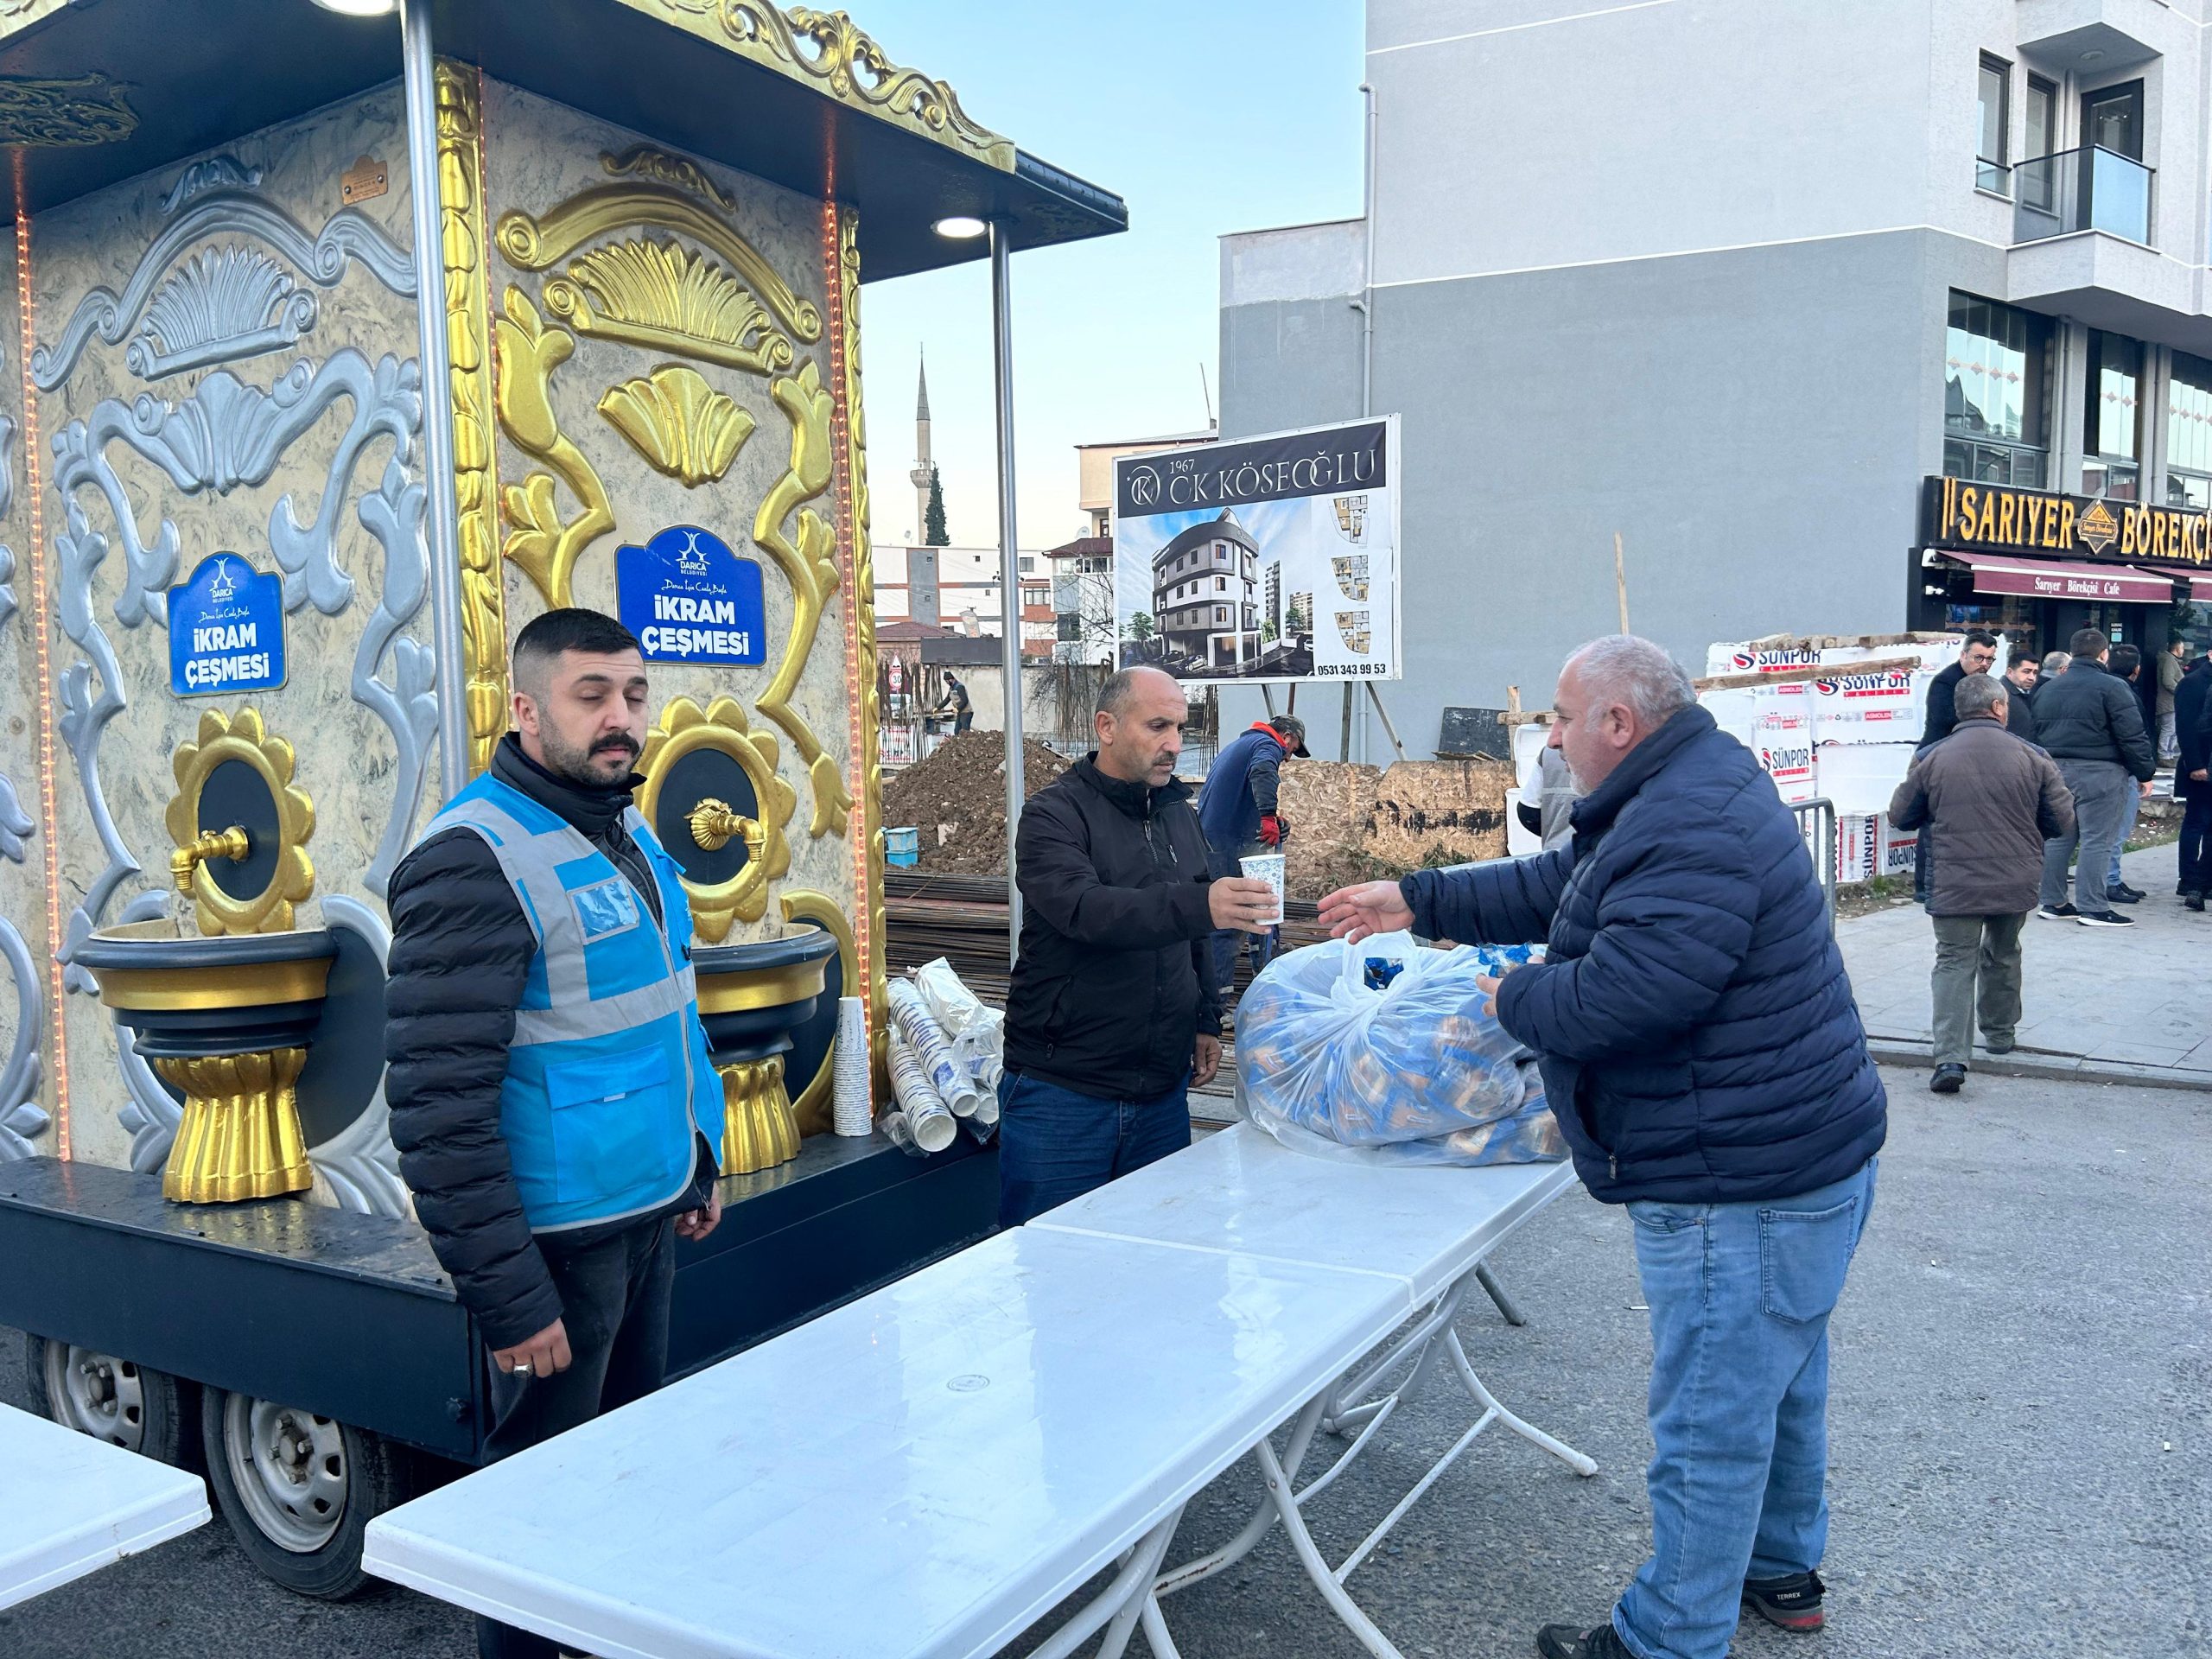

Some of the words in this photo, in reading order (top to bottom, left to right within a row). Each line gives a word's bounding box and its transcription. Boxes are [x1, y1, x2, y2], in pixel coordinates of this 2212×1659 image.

[1169, 459, 1194, 474] 1967
[1169, 472, 1210, 505] CK
[1217, 449, 1376, 500] KÖSEOĞLU
[1960, 486, 2075, 550] SARIYER
[680, 561, 707, 571] DARICA
[2034, 576, 2062, 594] Sarıyer
[2067, 579, 2099, 596] Börekçisi
[2103, 582, 2120, 595] Cafe
[654, 594, 735, 625] İKRAM
[193, 622, 257, 653] İKRAM
[641, 626, 750, 658] ÇEŞMESİ
[184, 652, 270, 690] ÇEŞMESİ
[1318, 664, 1338, 676] 0531
[1340, 664, 1357, 675] 343
[1360, 664, 1371, 674] 99
[1374, 664, 1386, 674] 53
[1772, 747, 1809, 770] SÜNPOR
[1777, 1592, 1802, 1600] TERREX
